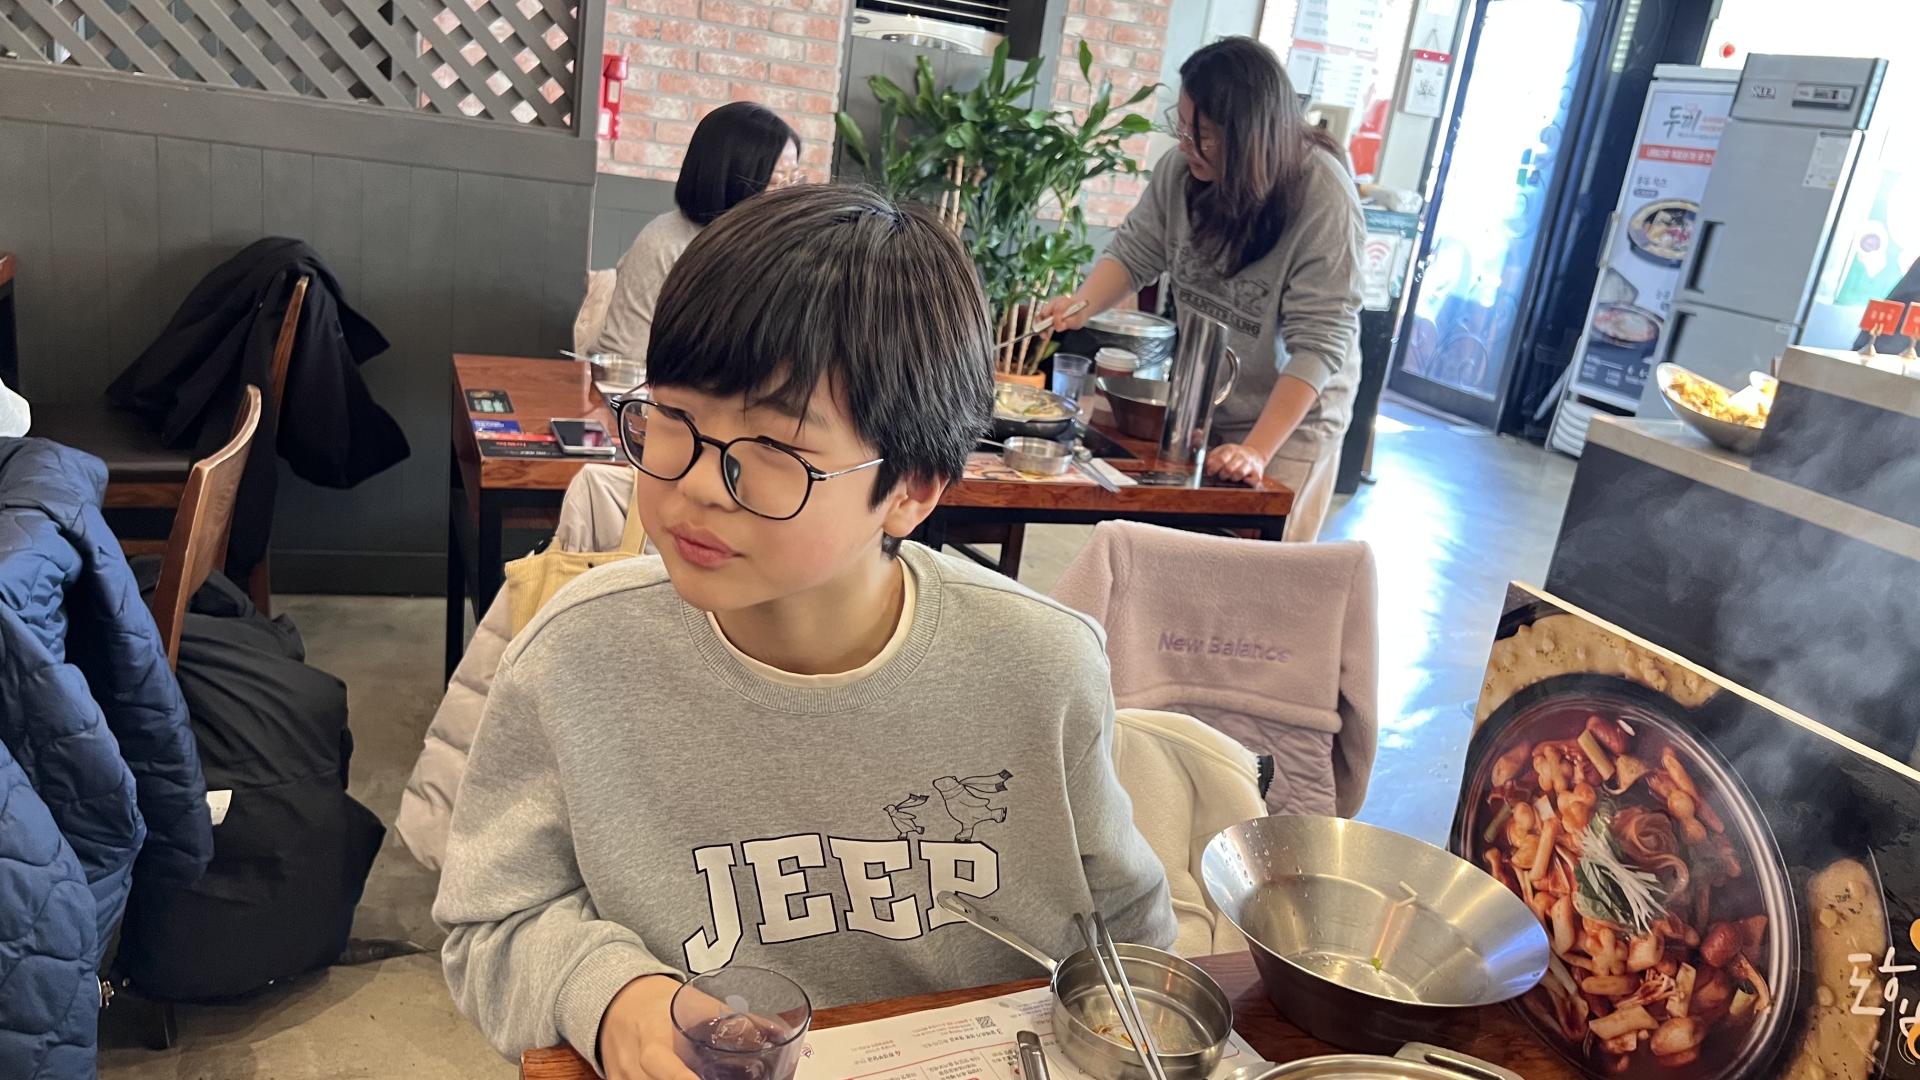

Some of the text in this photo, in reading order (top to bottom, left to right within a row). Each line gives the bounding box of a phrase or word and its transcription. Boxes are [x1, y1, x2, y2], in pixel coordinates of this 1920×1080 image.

[1158, 631, 1292, 664] New Balance
[682, 833, 1001, 975] JEEP
